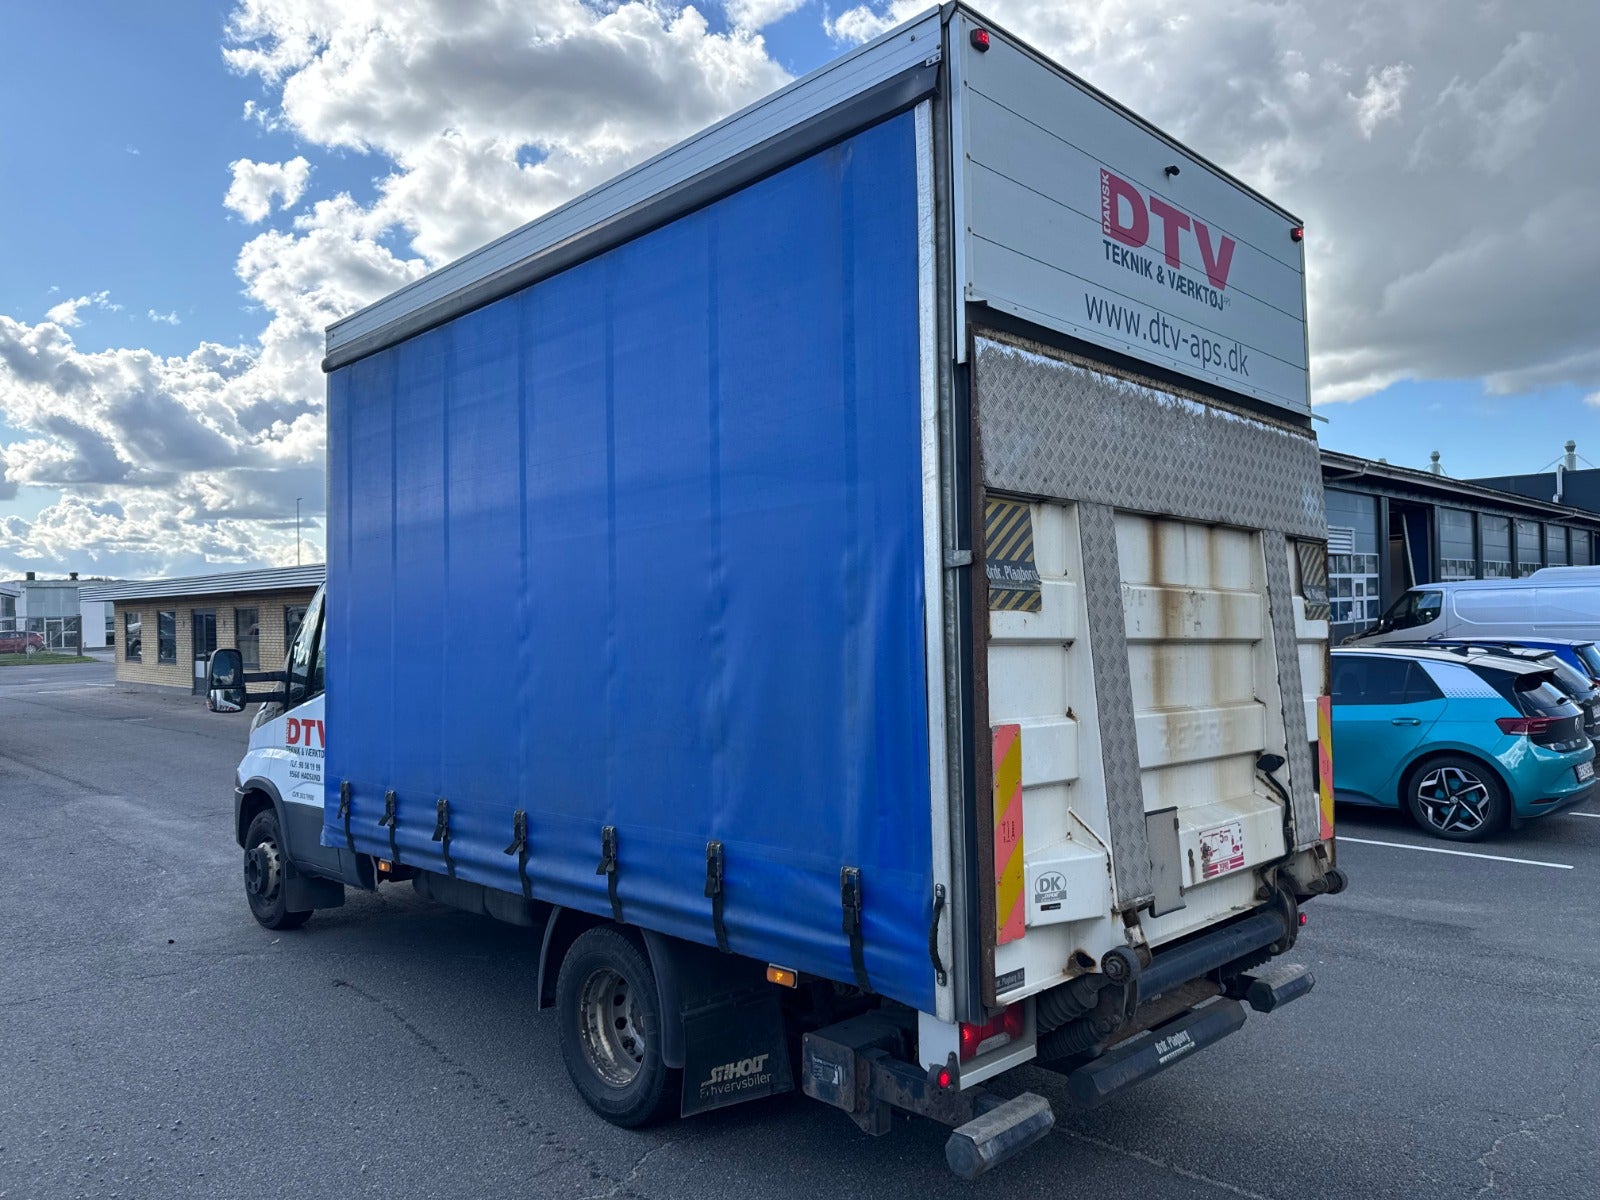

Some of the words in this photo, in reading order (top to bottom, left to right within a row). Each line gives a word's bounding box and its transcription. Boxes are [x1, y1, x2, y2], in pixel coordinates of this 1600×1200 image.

[1101, 168, 1236, 291] DTV
[1103, 172, 1111, 234] DANSK
[1103, 239, 1153, 280] TEKNIK
[1156, 265, 1165, 284] &
[1168, 270, 1224, 310] VÆRKTØJ
[1085, 293, 1249, 376] www.dtv-aps.dk
[1040, 876, 1061, 892] DK
[701, 1053, 769, 1087] STIHOLT
